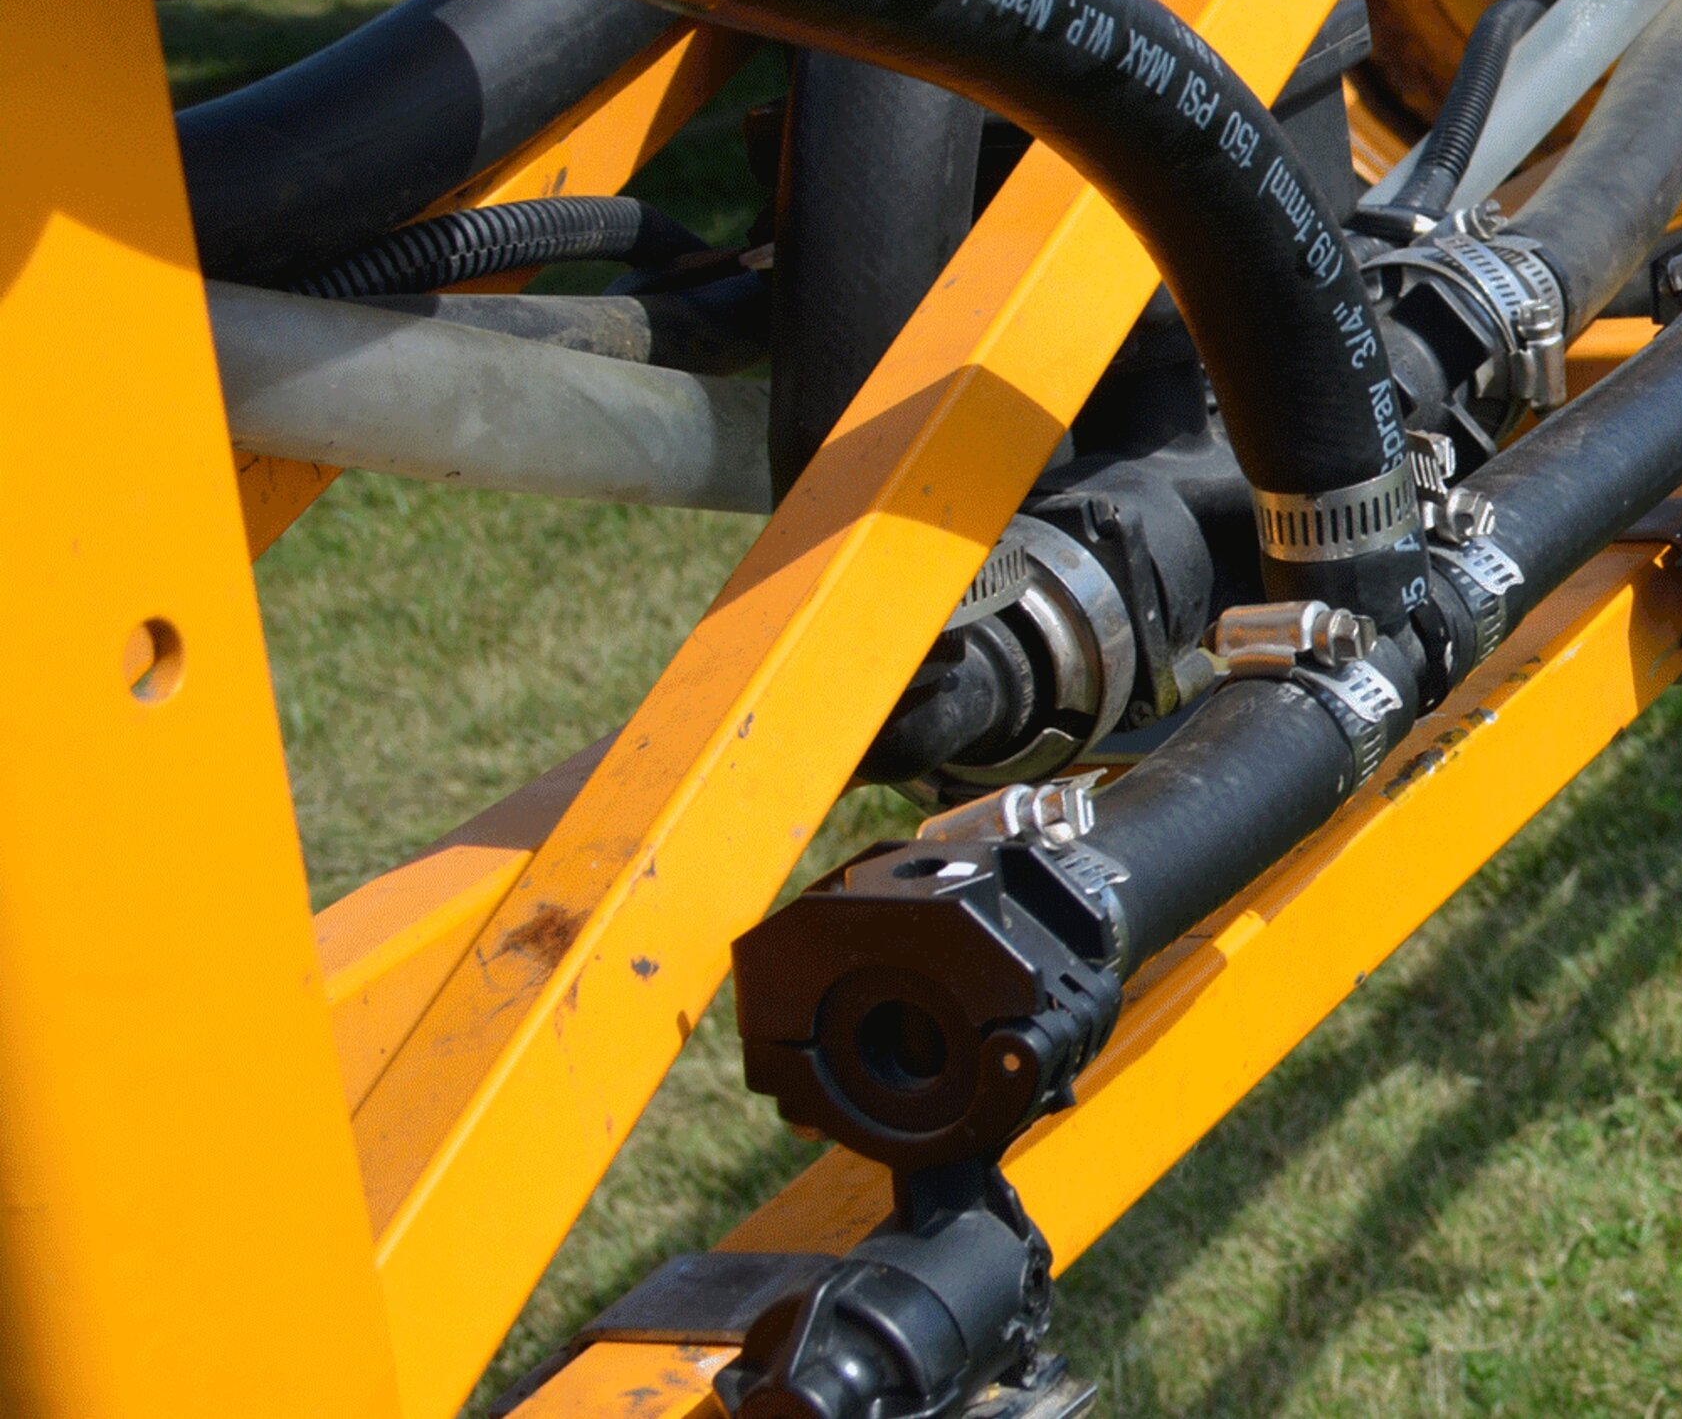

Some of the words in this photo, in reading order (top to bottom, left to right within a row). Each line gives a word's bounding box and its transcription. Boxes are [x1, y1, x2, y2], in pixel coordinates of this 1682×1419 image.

[1118, 28, 1177, 96] MAX
[1176, 70, 1221, 131] PSI
[1218, 109, 1261, 170] 150
